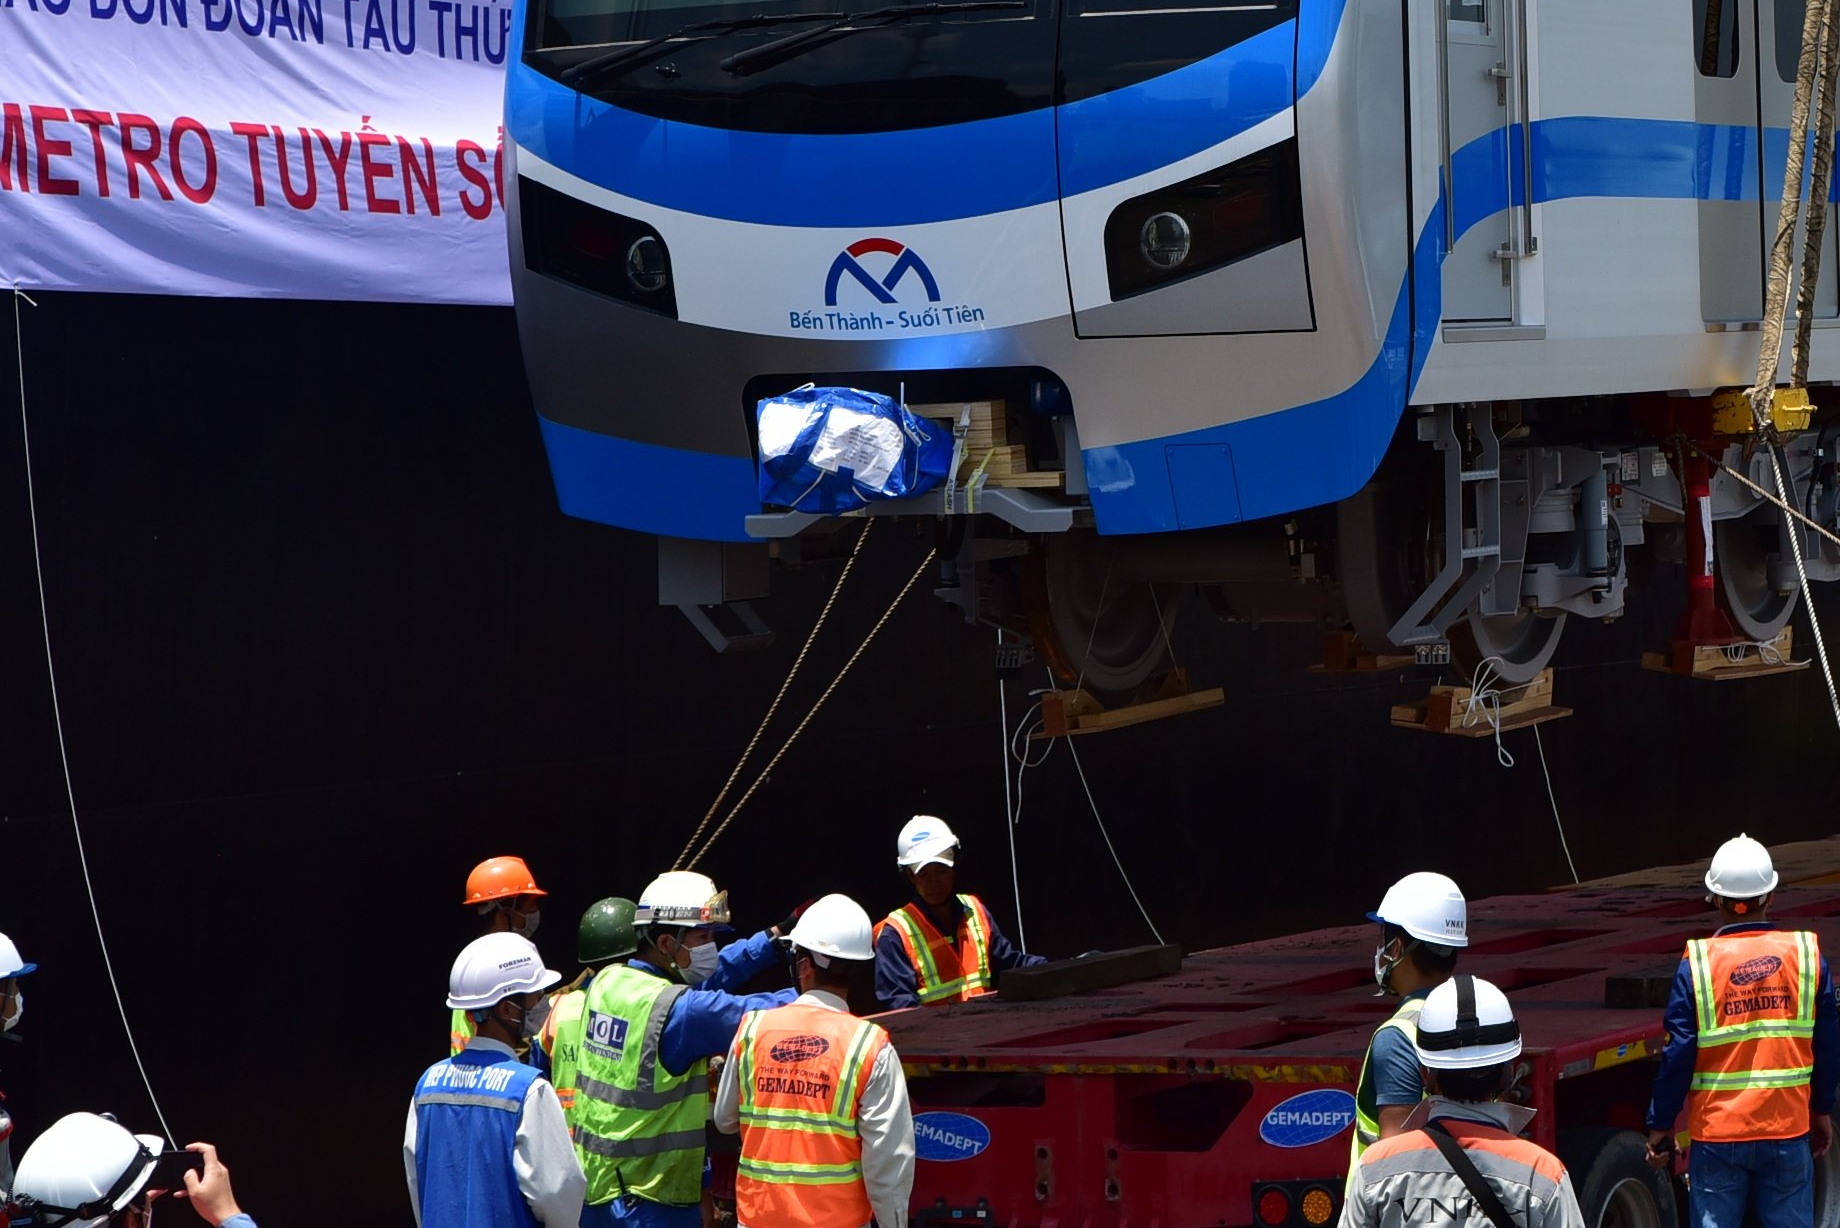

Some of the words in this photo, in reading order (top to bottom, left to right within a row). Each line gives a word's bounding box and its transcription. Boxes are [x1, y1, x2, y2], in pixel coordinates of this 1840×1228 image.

[0, 102, 218, 205] METRO
[229, 115, 441, 217] TUYẾN
[789, 309, 823, 330] Bến
[825, 311, 883, 331] Thành
[898, 306, 941, 329] Suối
[943, 305, 985, 325] Tiên
[498, 957, 532, 970] FOREMAN
[1724, 994, 1791, 1016] GEMADEPT
[477, 1066, 516, 1093] PORT
[760, 1066, 775, 1074] THE
[776, 1067, 795, 1075] WAY
[795, 1069, 831, 1081] FORWARD
[757, 1076, 831, 1100] GEMADEPT
[1266, 1111, 1352, 1126] GEMADEPT
[913, 1122, 983, 1155] EMADEPT
